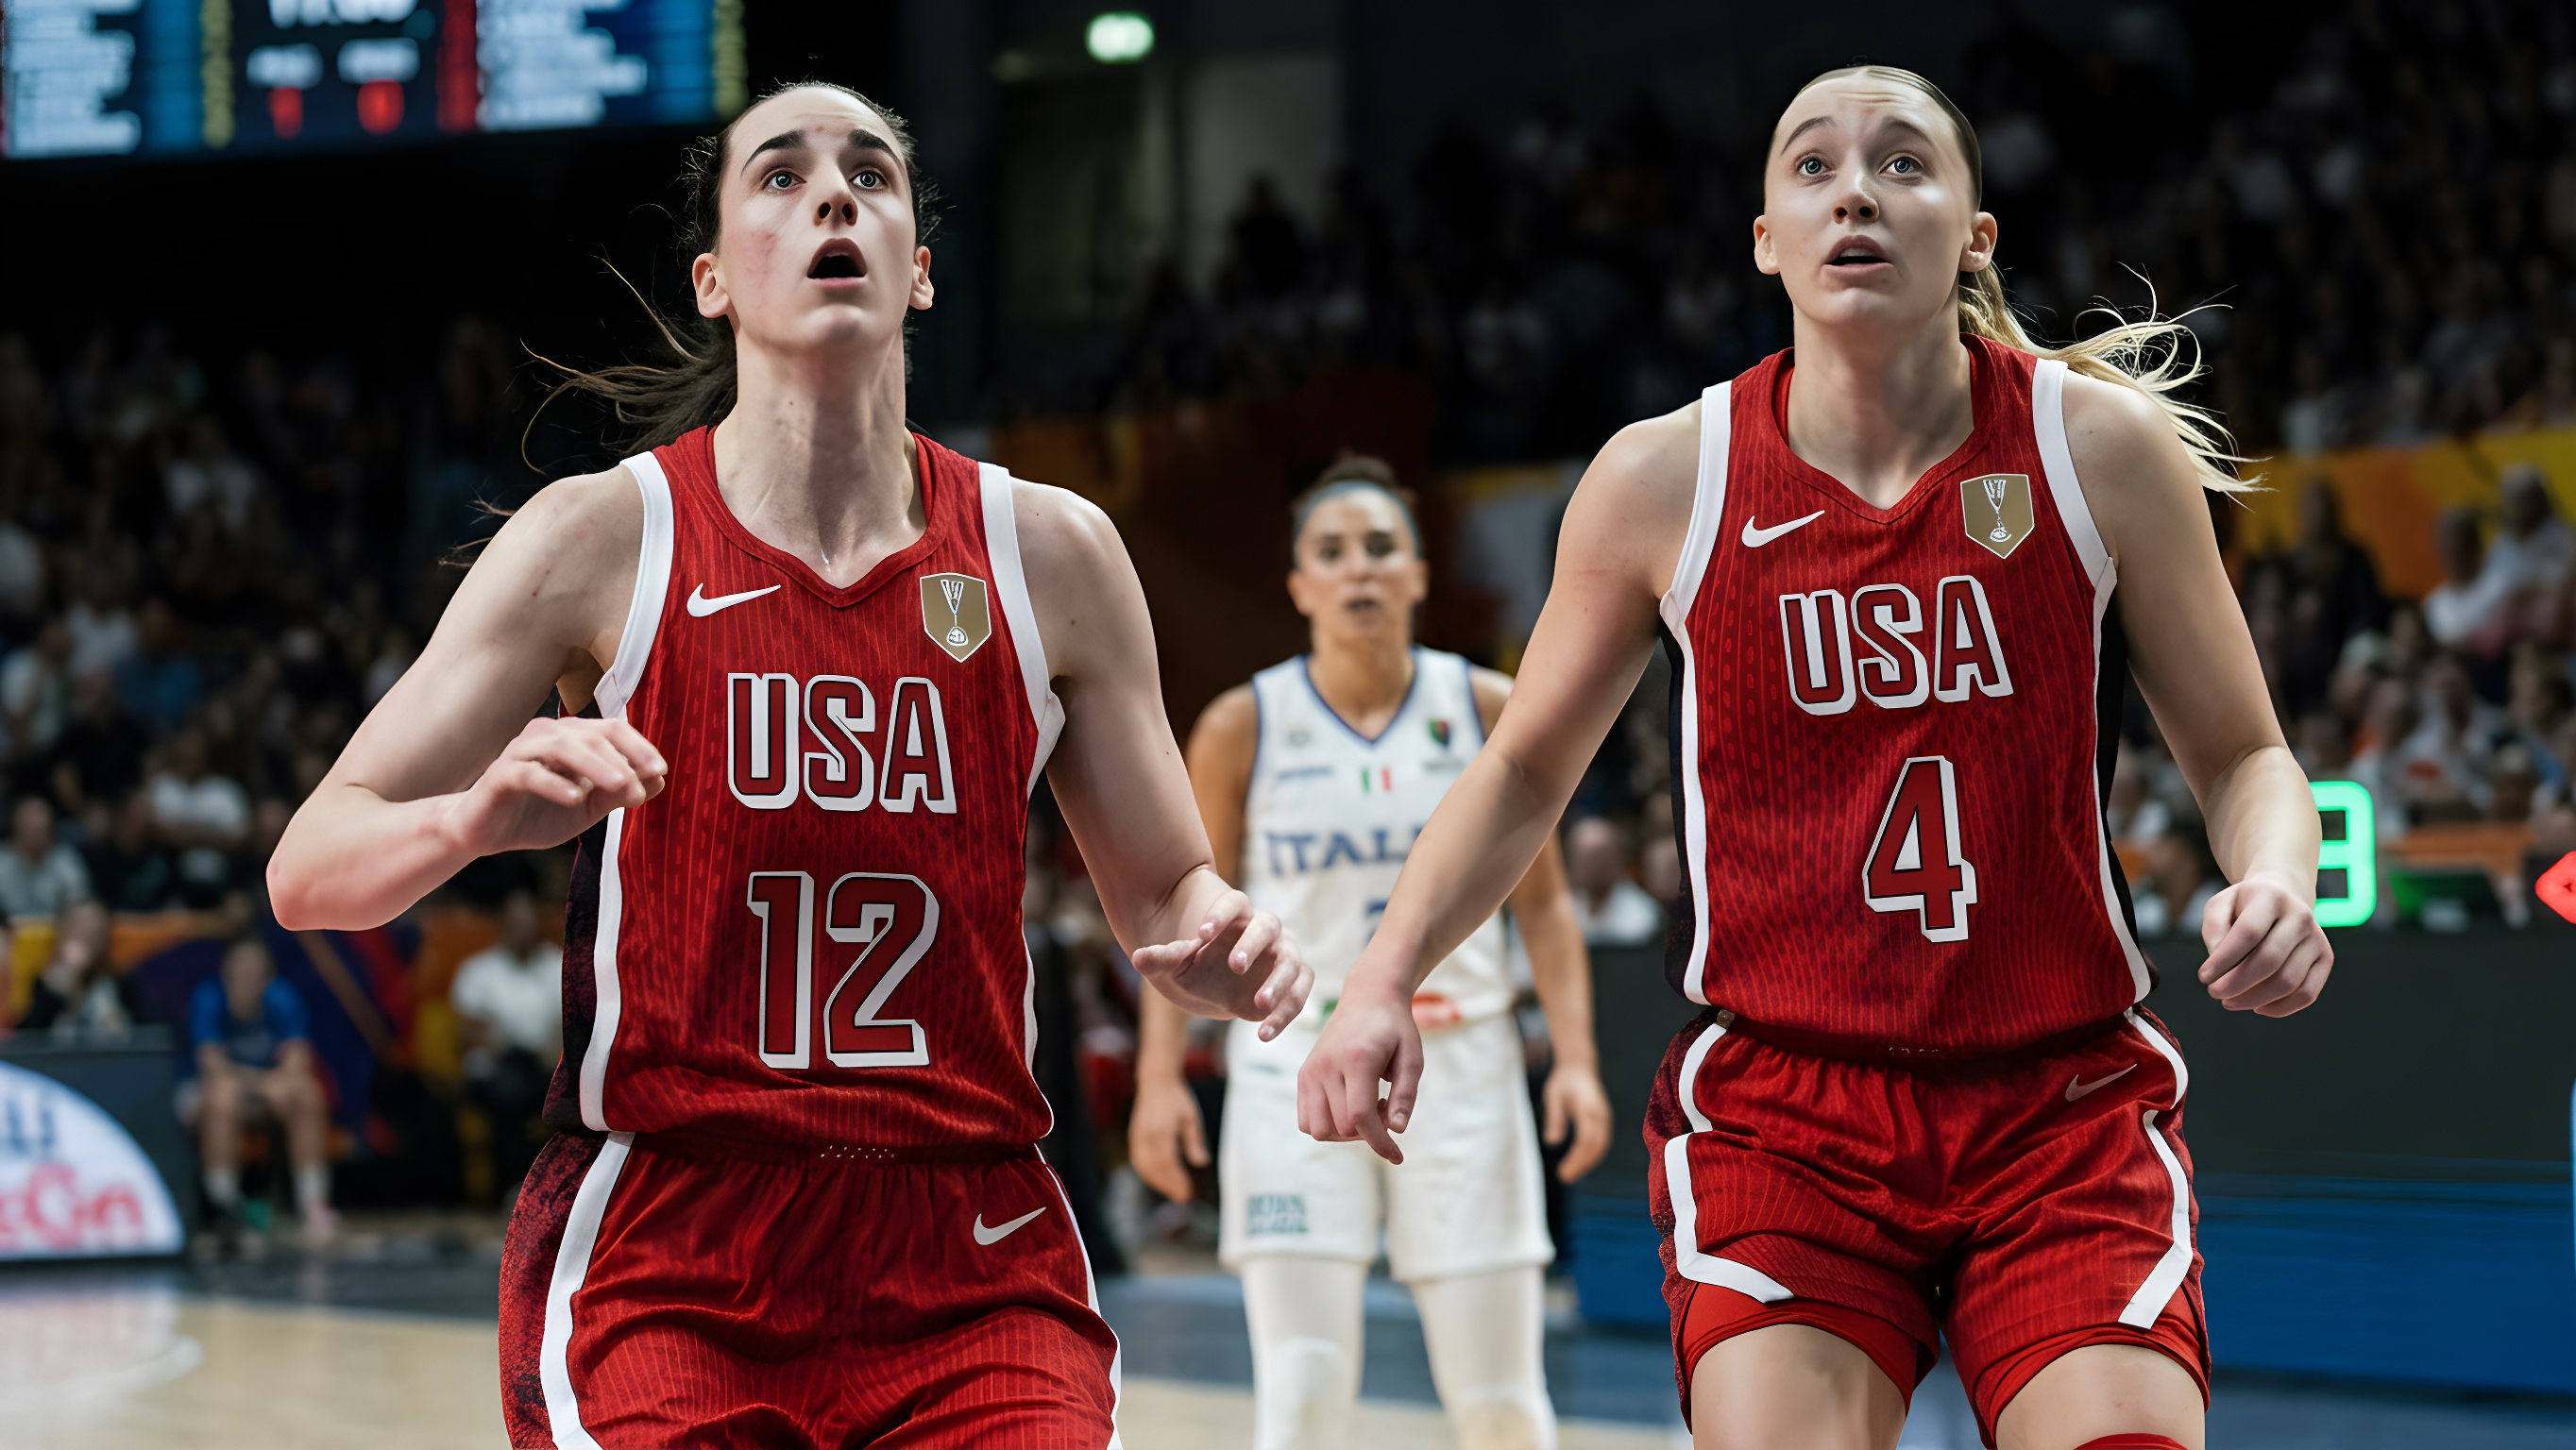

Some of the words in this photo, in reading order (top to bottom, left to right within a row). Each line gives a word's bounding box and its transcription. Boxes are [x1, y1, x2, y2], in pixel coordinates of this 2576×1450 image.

[1779, 575, 2013, 716] USA
[728, 673, 957, 814] USA
[1266, 826, 1424, 876] ITAL
[1862, 755, 1977, 942] 4
[747, 870, 940, 1069] 12
